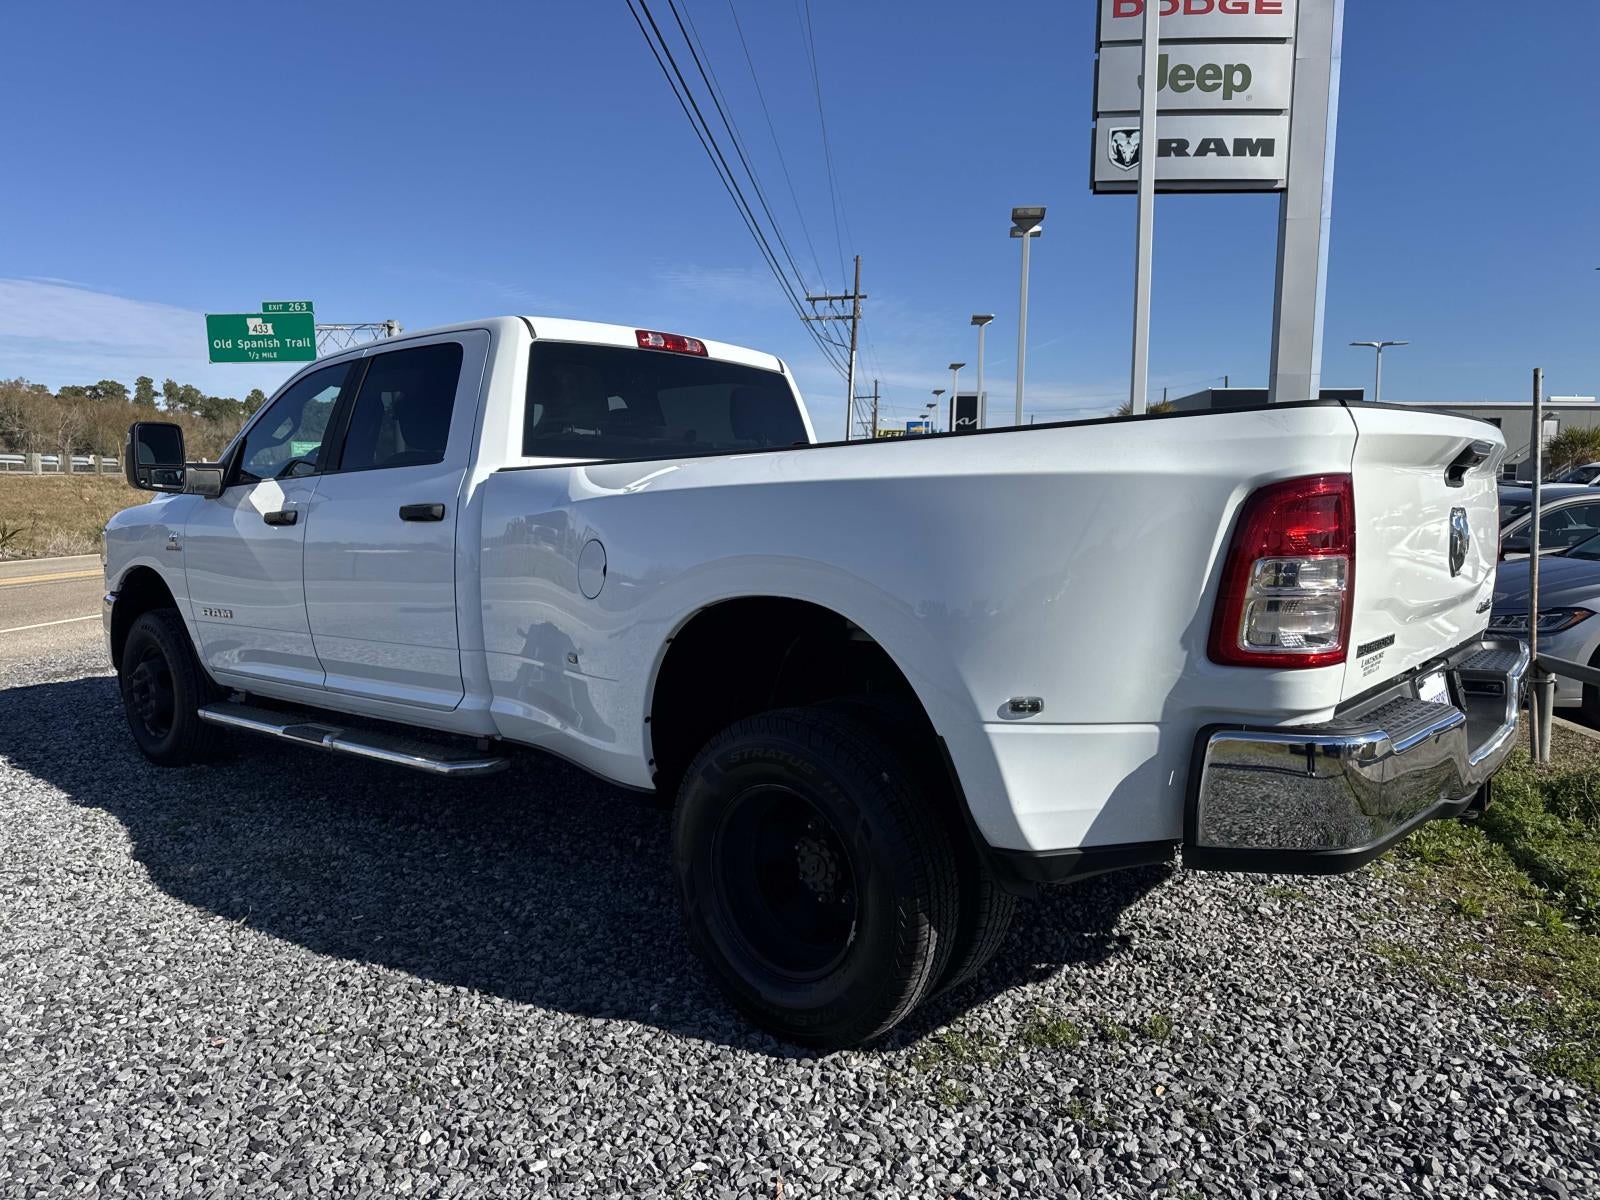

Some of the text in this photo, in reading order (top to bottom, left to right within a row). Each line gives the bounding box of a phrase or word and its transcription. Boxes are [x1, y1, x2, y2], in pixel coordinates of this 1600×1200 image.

[1113, 0, 1283, 18] DODGE
[1138, 54, 1252, 100] Jeep
[1157, 138, 1275, 157] RAM
[288, 302, 307, 311] 263
[252, 324, 269, 334] 433
[213, 338, 311, 350] Old Spanish Trail
[201, 607, 233, 618] RAM
[728, 747, 817, 775] STRATUS
